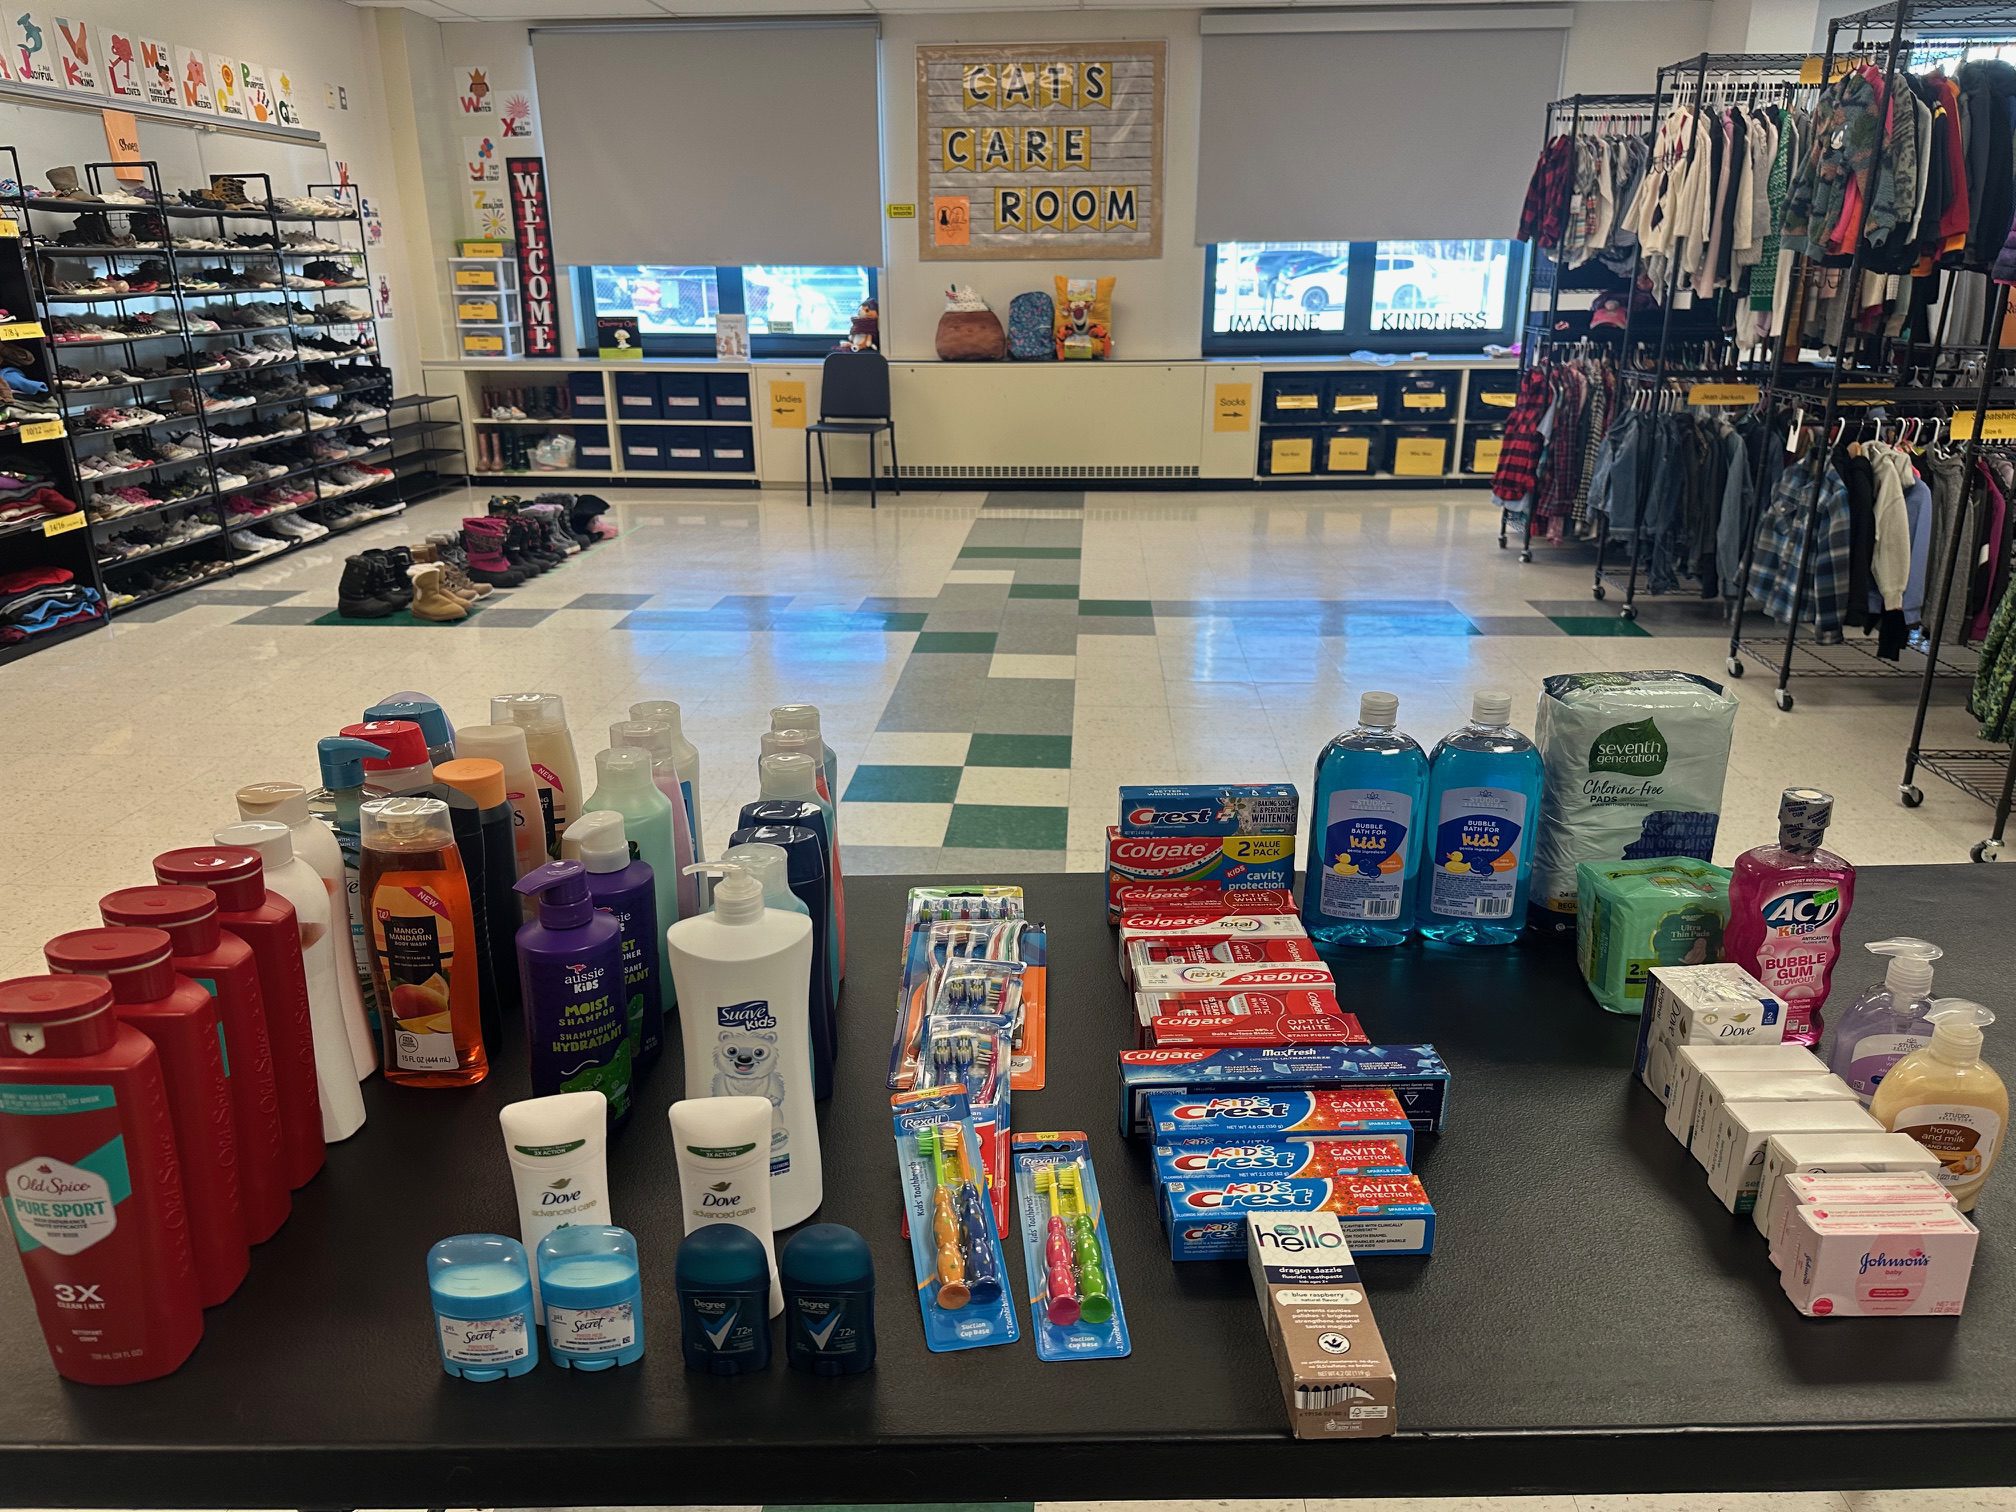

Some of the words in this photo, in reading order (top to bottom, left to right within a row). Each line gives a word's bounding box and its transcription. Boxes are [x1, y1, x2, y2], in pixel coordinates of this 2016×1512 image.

[80, 78, 94, 87] KIND
[969, 66, 1104, 101] CATS
[948, 129, 1083, 163] CARE
[1001, 190, 1135, 223] ROOM
[513, 172, 553, 351] WELCOME
[1229, 313, 1320, 332] IMAGINE
[1382, 312, 1487, 330] KINDNESS
[775, 394, 802, 405] Undies
[1220, 398, 1246, 407] Socks
[1598, 741, 1661, 755] seventh
[538, 767, 555, 781] NEW
[1129, 808, 1212, 826] Crest
[1252, 814, 1296, 823] WHITENING
[1350, 835, 1387, 849] kids
[1461, 833, 1500, 848] kids
[1116, 842, 1206, 862] Colgate
[1238, 841, 1250, 857] 2
[1227, 864, 1246, 878] KIDS
[1246, 869, 1284, 882] cavity
[1228, 881, 1285, 890] protection
[417, 891, 438, 908] NEW
[1767, 898, 1833, 921] ACT
[1126, 918, 1207, 926] Colgate
[389, 933, 432, 941] MANDARIN
[1778, 924, 1814, 937] Kids
[1233, 945, 1244, 960] WHITE
[1241, 945, 1253, 960] OPTIC
[1630, 963, 1639, 975] 2
[1765, 953, 1826, 970] BUBBLE
[564, 966, 605, 984] aussie
[1240, 972, 1328, 982] Colgate
[1777, 966, 1813, 979] GUM
[1773, 976, 1815, 987] BLOWOUT
[565, 995, 609, 1017] MOIST
[1251, 997, 1262, 1015] WHITE
[1259, 997, 1271, 1015] OPTIC
[1656, 988, 1665, 1019] original
[558, 1006, 615, 1027] SHAMPOO
[720, 1005, 766, 1022] Suave
[1670, 999, 1680, 1037] Dove
[745, 1016, 776, 1030] kids
[1156, 1017, 1234, 1027] Colgate
[559, 1019, 617, 1041] SHAMPOOING
[1719, 1023, 1755, 1037] Dove
[552, 1024, 622, 1053] HYDRATANT
[1123, 1051, 1203, 1061] Colgate
[1262, 1048, 1316, 1056] MaxFresh
[1210, 1096, 1270, 1108] KID'S
[1173, 1103, 1289, 1120] Crest
[904, 1115, 942, 1128] Rexall
[1922, 1132, 1942, 1141] and
[1944, 1134, 1966, 1143] milk
[1929, 1125, 1962, 1136] honey
[543, 1148, 566, 1156] ACTION
[1212, 1144, 1275, 1158] KID'S
[1330, 1147, 1388, 1156] CAVITY
[1022, 1156, 1060, 1166] Rexall
[1173, 1152, 1295, 1172] Crest
[17, 1174, 43, 1192] Old
[47, 1177, 90, 1195] Spice
[908, 1161, 922, 1199] Toothbrush
[1226, 1181, 1291, 1194] KID'S
[1349, 1183, 1408, 1193] CAVITY
[541, 1190, 581, 1205] Dove
[702, 1192, 741, 1207] Dove
[1186, 1189, 1312, 1208] Crest
[15, 1198, 50, 1217] PURE
[53, 1200, 108, 1217] SPORT
[531, 1205, 577, 1217] advanced
[577, 1199, 597, 1212] care
[693, 1209, 735, 1219] advanced
[736, 1206, 756, 1217] care
[914, 1198, 925, 1216] Kids'
[1024, 1195, 1036, 1227] Toothbrush
[1254, 1224, 1343, 1252] hello
[1802, 1253, 1812, 1286] Johnson's
[1859, 1252, 1931, 1275] Johnson's
[53, 1284, 104, 1303] 3X
[693, 1298, 726, 1309] Degree
[798, 1298, 830, 1310] Degree
[571, 1317, 606, 1333] Secret
[960, 1322, 986, 1330] Suction
[463, 1328, 498, 1344] Secret
